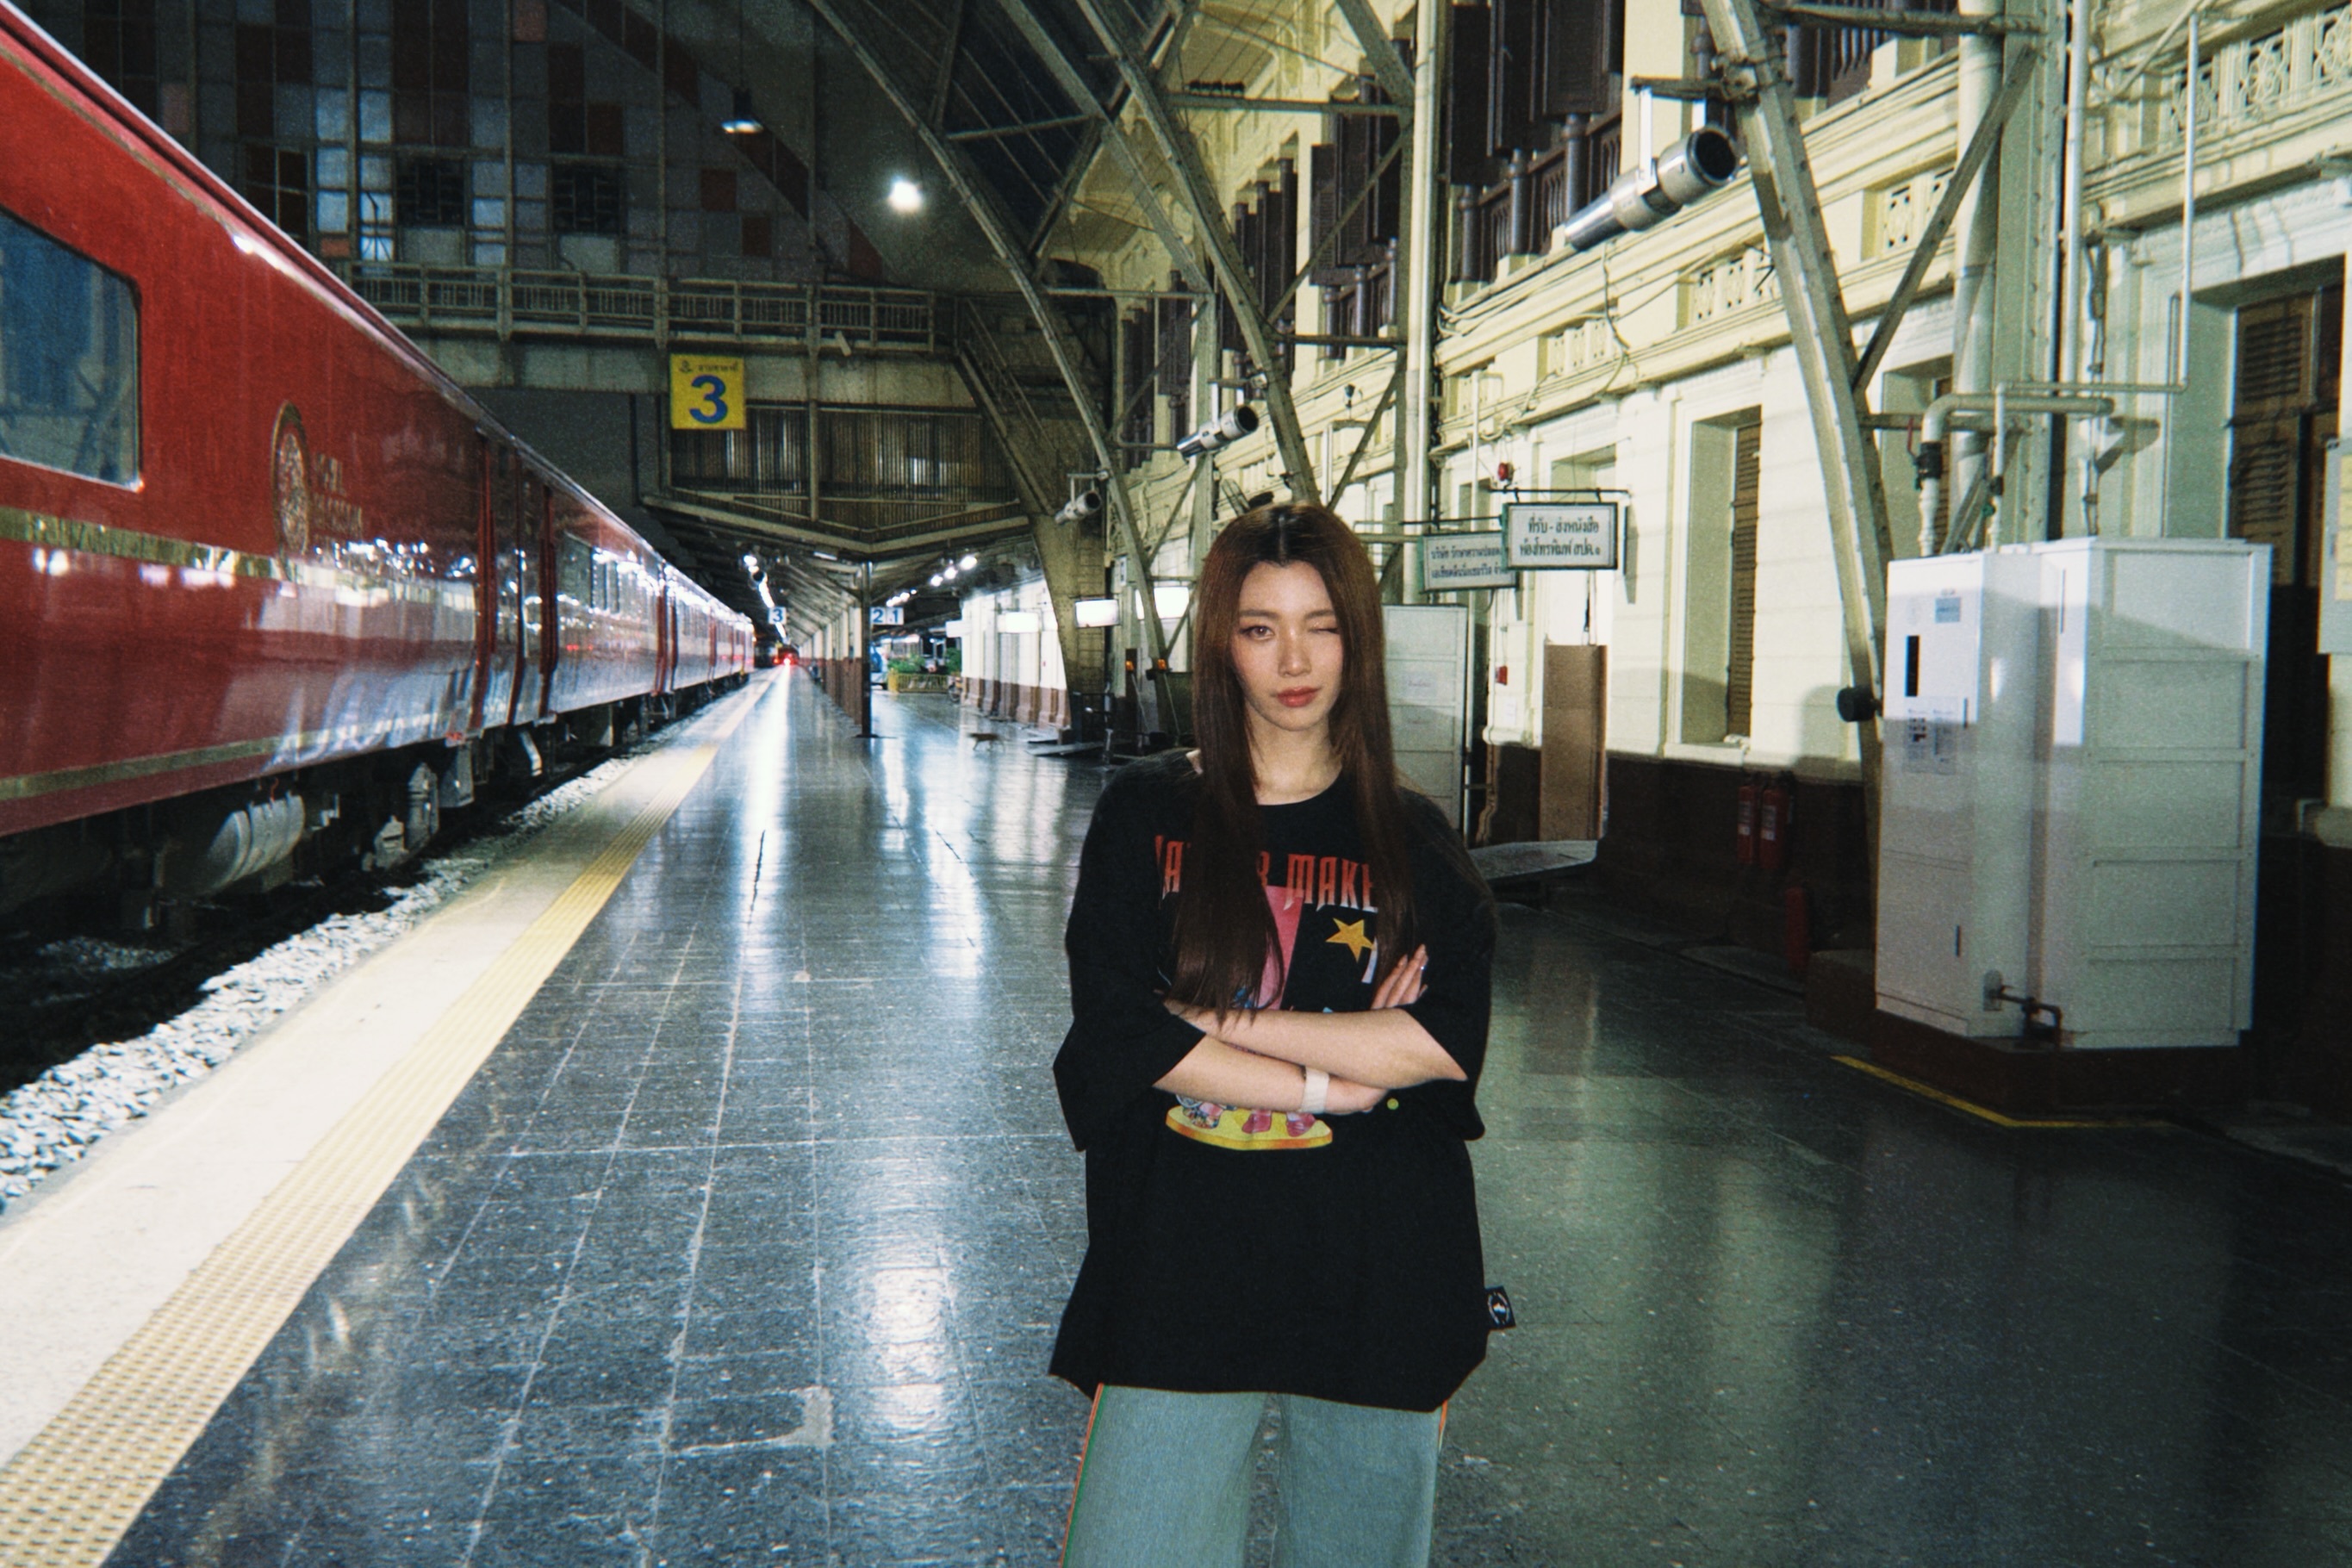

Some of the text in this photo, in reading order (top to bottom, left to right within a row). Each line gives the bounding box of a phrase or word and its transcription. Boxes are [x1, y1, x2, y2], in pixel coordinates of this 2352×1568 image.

[689, 374, 728, 424] 3
[772, 608, 783, 623] 3
[872, 608, 899, 624] 2 1
